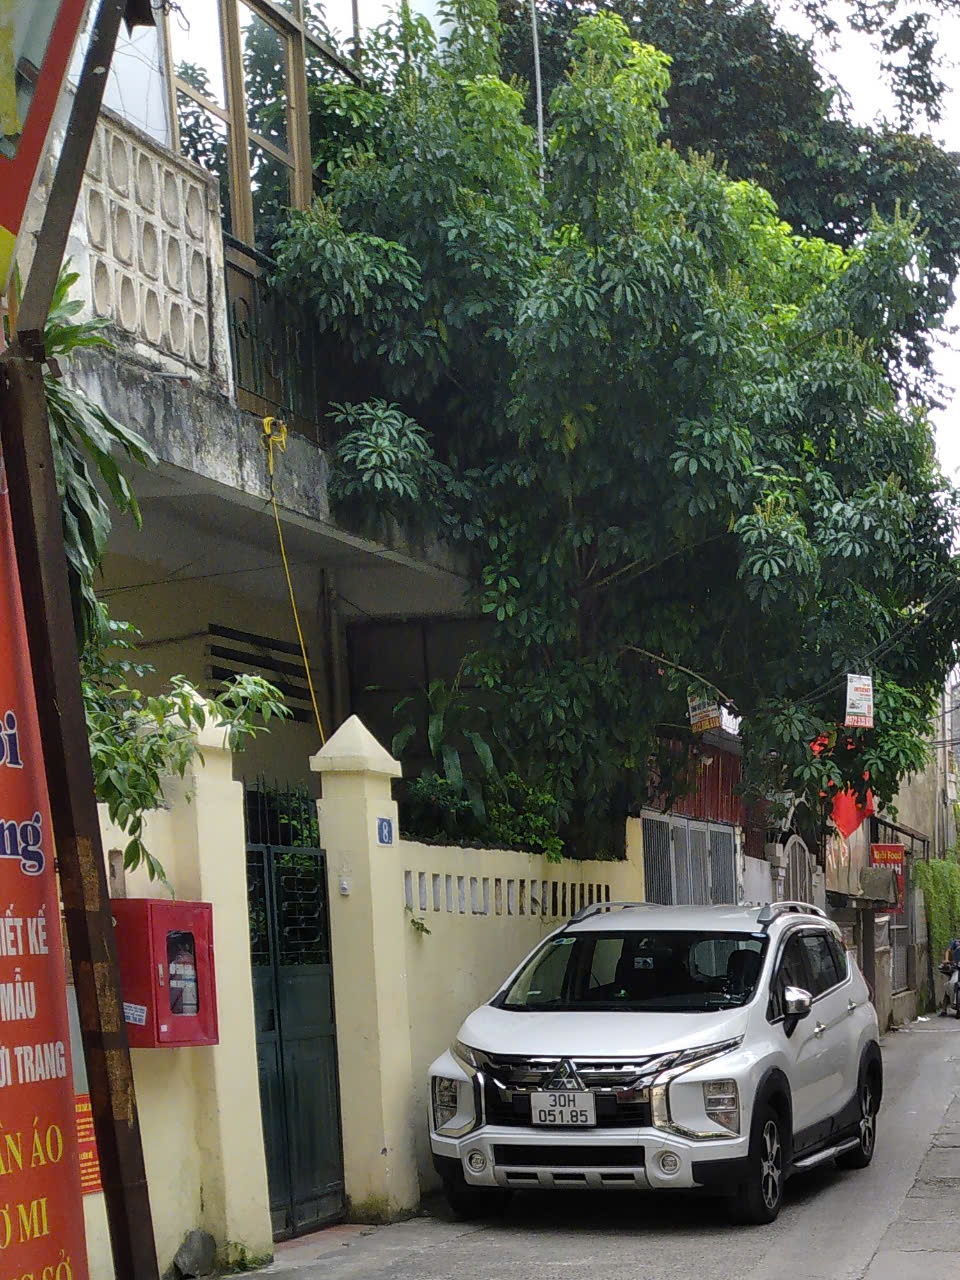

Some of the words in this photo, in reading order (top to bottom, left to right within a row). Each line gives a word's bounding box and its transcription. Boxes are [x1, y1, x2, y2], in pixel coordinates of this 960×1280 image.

[27, 903, 49, 955] KẾ
[0, 967, 37, 1022] MẪU
[14, 1041, 67, 1085] TRANG
[538, 1109, 588, 1123] 051.85
[549, 1094, 576, 1108] 30H
[30, 1116, 63, 1169] ÁO
[17, 1197, 50, 1243] MI
